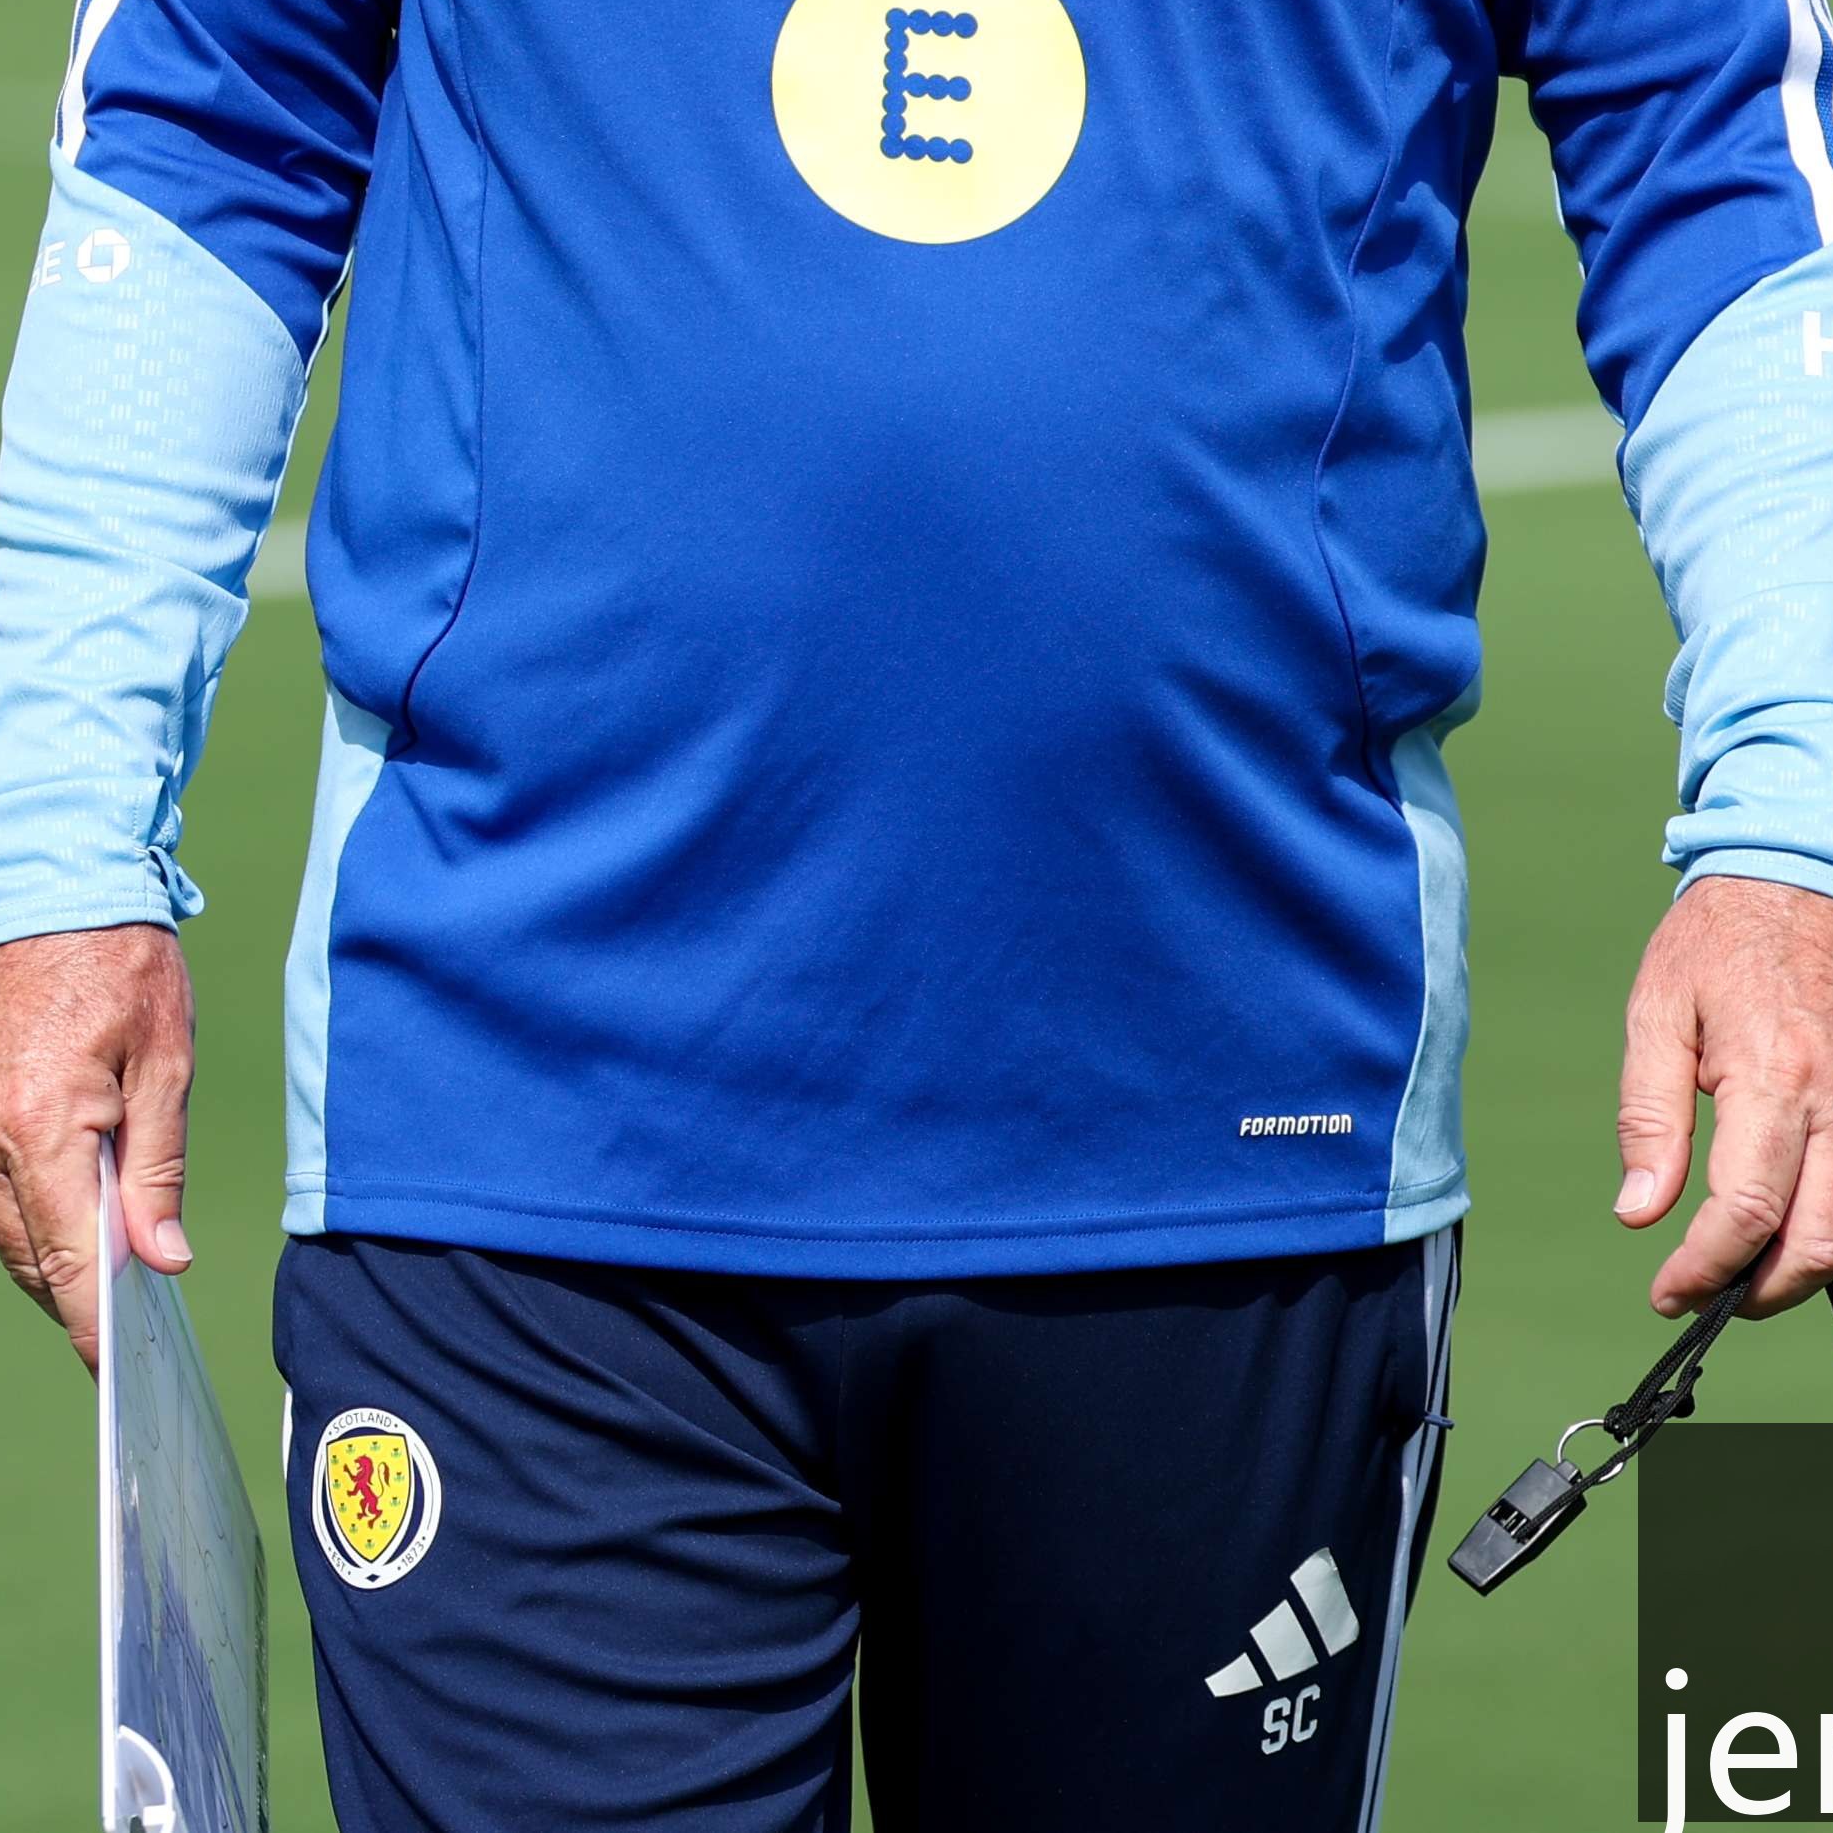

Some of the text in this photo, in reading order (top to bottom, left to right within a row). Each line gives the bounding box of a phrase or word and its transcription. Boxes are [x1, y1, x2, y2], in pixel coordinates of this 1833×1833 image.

[1240, 1114, 1351, 1136] FORMOTION
[333, 1412, 392, 1433] SCOTLAND
[330, 1551, 346, 1573] EST
[401, 1541, 424, 1567] 1873
[1261, 1684, 1321, 1755] SC
